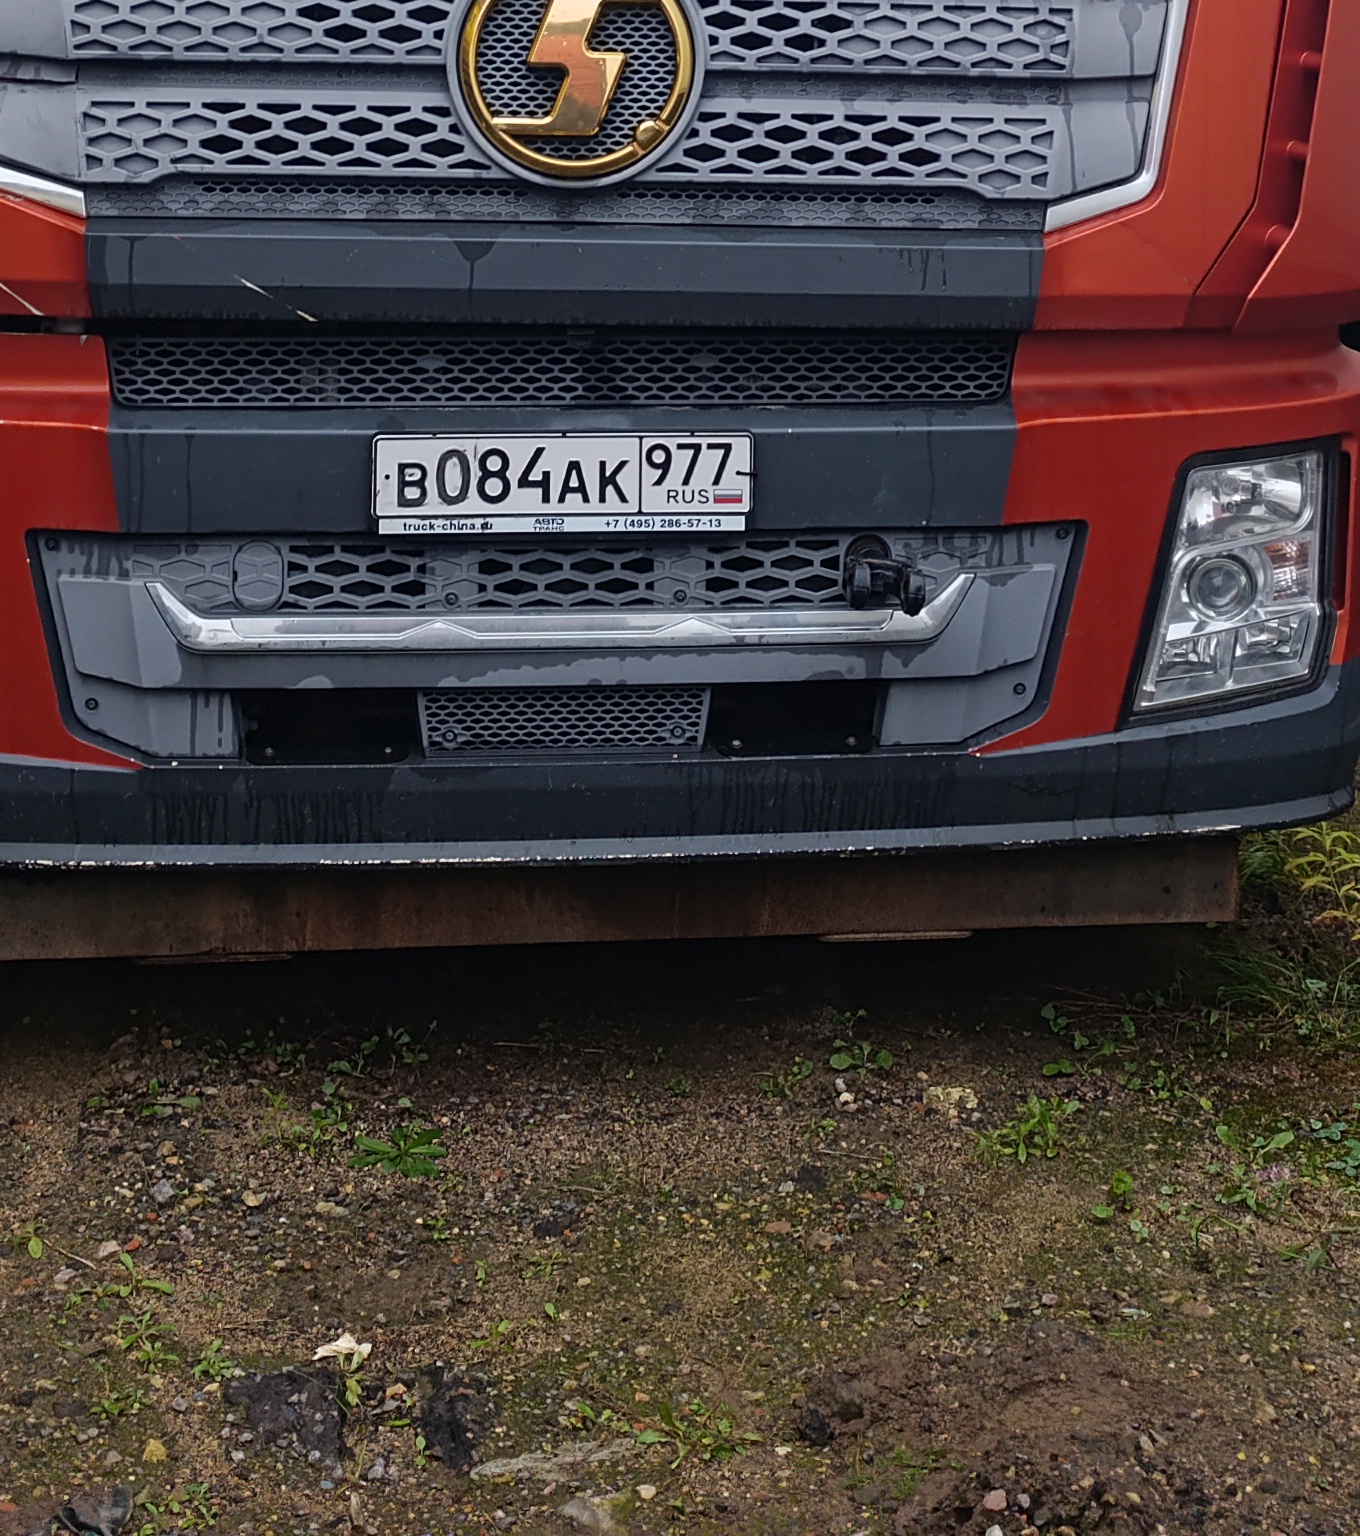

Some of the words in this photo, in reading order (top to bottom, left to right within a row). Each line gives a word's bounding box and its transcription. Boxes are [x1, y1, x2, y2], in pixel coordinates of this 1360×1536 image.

[644, 442, 733, 487] 977
[666, 489, 710, 504] RUS
[604, 519, 620, 529] +7
[624, 517, 656, 530] (495)
[659, 519, 722, 529] 286-57-13
